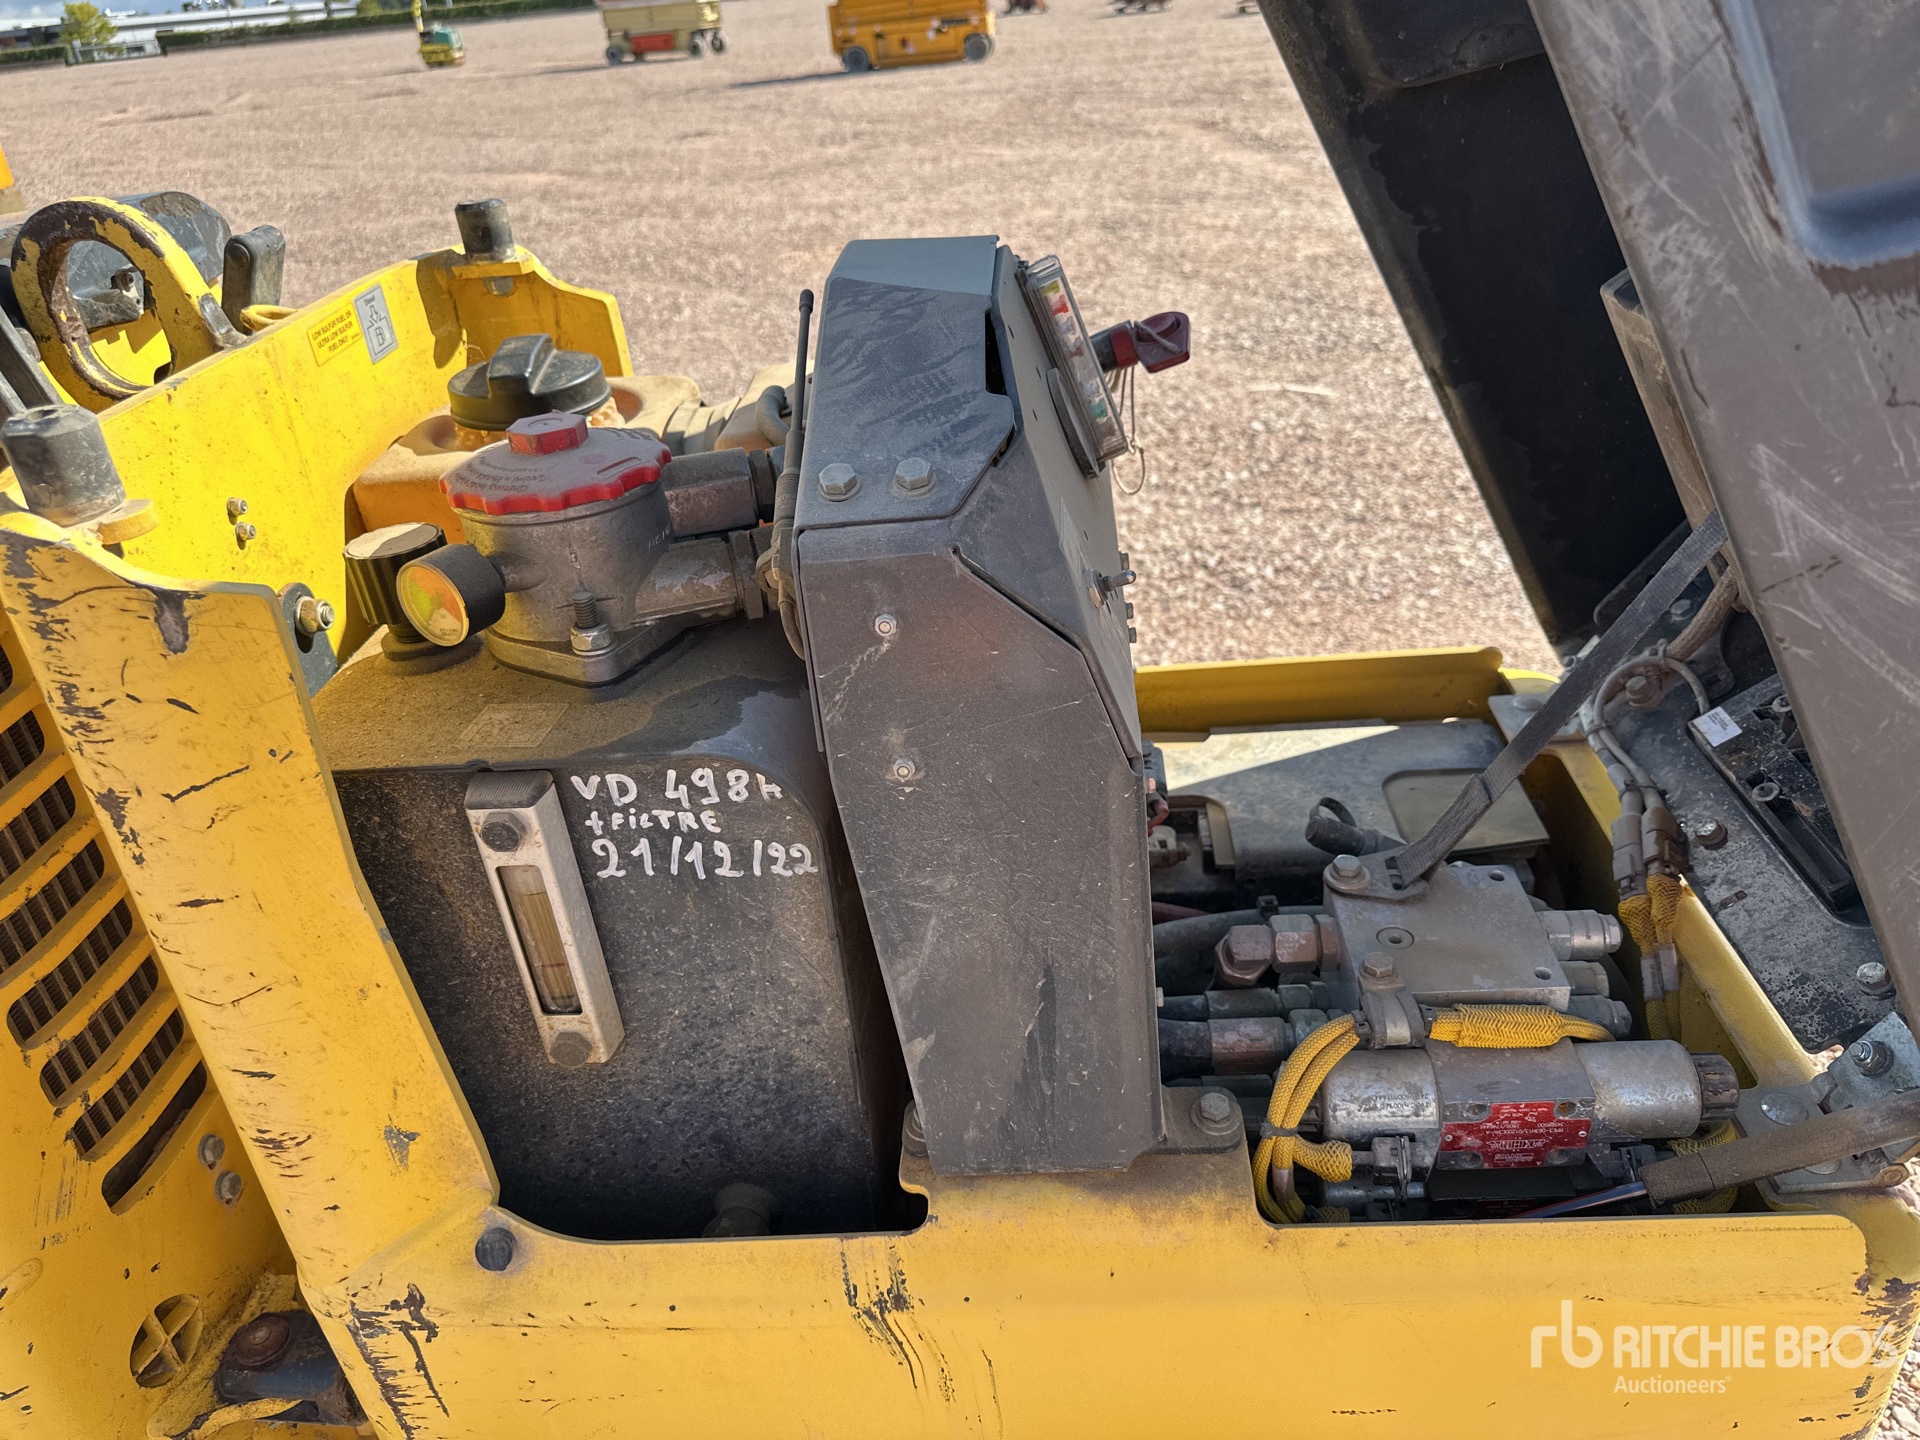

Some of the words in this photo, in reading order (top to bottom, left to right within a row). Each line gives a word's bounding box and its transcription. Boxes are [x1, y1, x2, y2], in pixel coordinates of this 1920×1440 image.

[312, 332, 322, 341] LOW
[321, 320, 336, 335] SULFUR
[336, 315, 346, 324] FUEL
[318, 336, 330, 349] ULTRA
[330, 331, 338, 340] LOW
[338, 321, 352, 334] SULFUR
[328, 343, 338, 352] FUEL
[338, 336, 348, 346] ONLY
[571, 773, 638, 807] VD
[591, 835, 819, 881] 21/12/22
